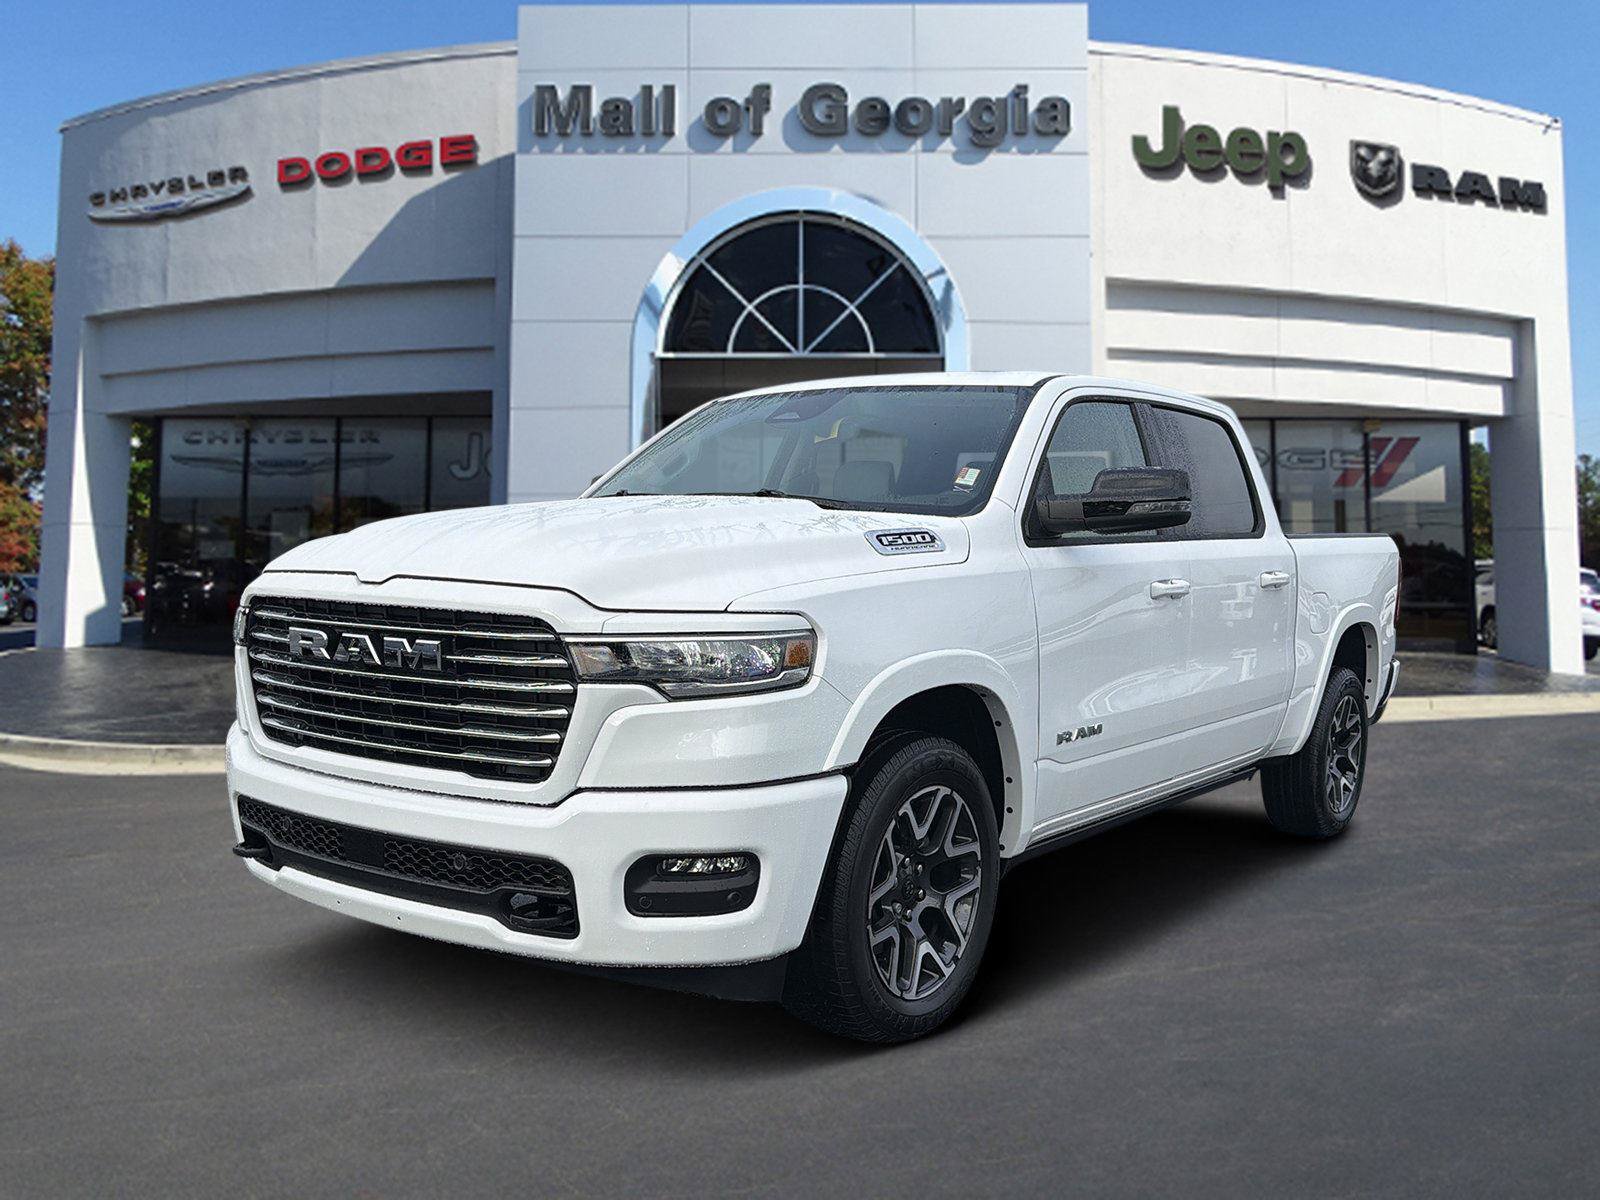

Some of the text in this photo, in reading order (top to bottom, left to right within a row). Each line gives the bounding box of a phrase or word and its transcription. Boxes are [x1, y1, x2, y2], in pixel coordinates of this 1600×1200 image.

[532, 84, 1072, 147] Mall of Georgia
[277, 134, 477, 186] DODGE
[1131, 105, 1311, 192] Jeep
[89, 165, 249, 207] CHRYSLER
[1411, 163, 1547, 214] RAM
[879, 532, 932, 546] 1500
[288, 627, 442, 671] RAM
[1056, 723, 1103, 746] RAM
